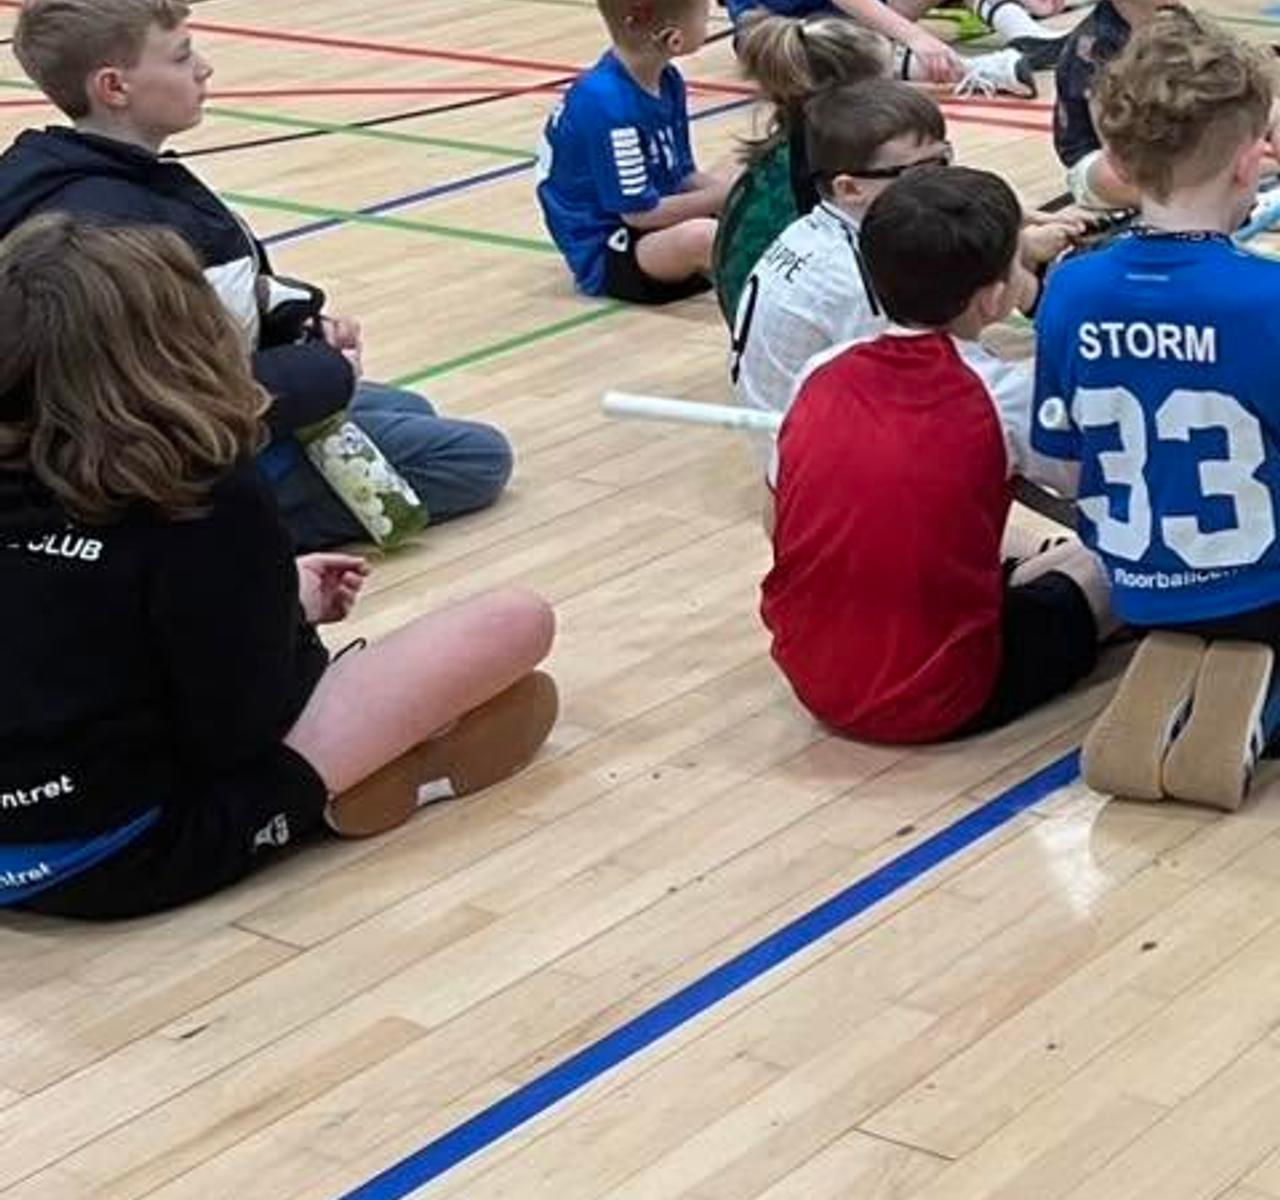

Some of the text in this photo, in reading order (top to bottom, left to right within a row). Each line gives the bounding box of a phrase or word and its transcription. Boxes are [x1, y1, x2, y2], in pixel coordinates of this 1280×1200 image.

[1078, 322, 1217, 363] STORM
[1071, 386, 1276, 569] 33
[0, 774, 76, 809] ntret
